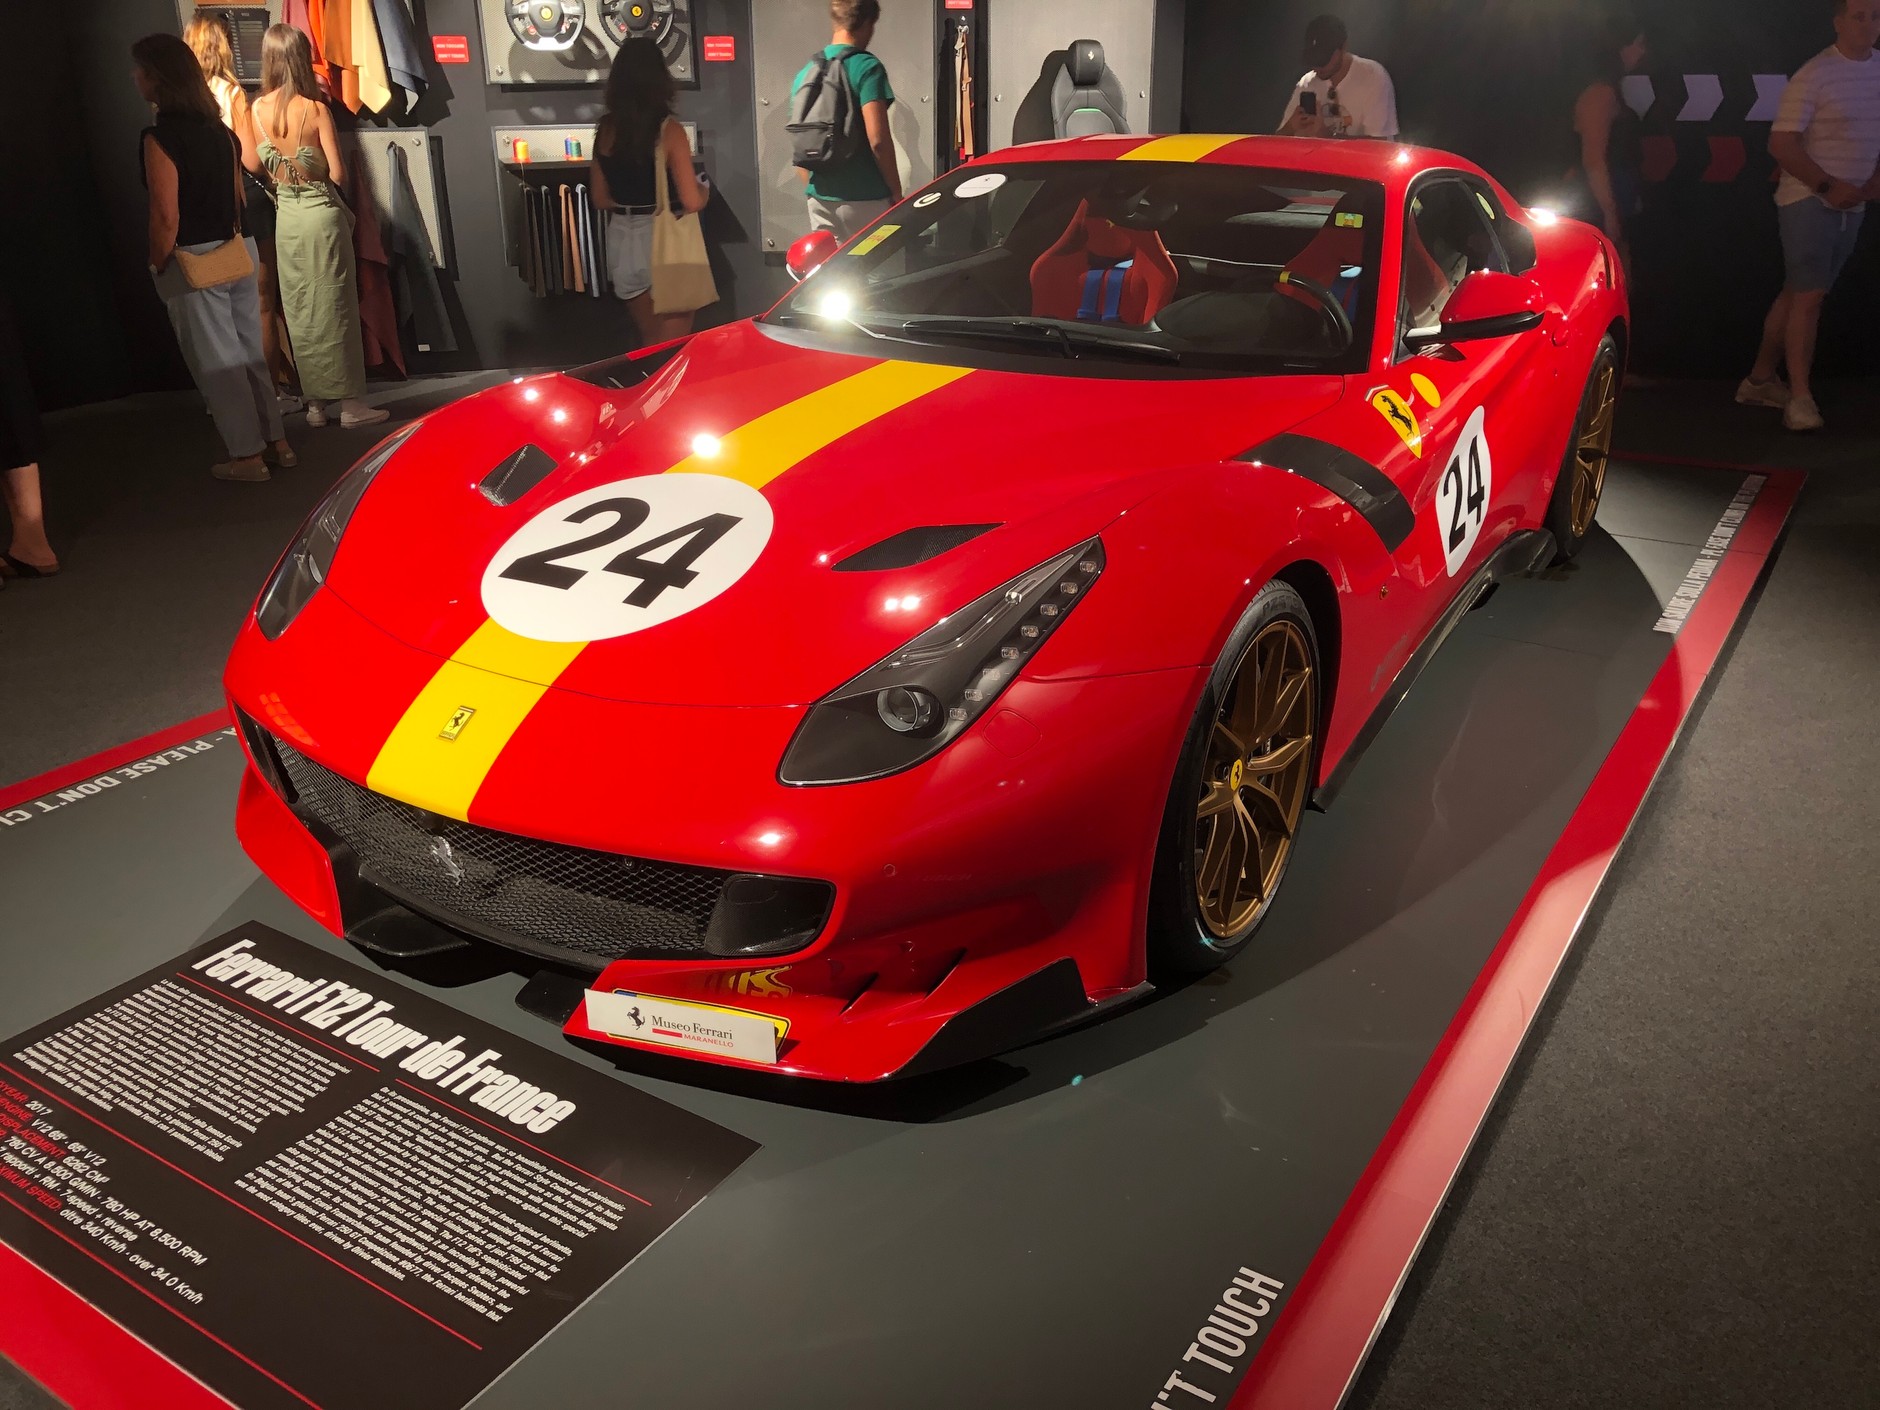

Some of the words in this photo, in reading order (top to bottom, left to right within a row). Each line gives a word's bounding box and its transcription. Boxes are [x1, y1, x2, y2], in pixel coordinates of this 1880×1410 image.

[1443, 435, 1485, 555] 24
[497, 497, 744, 609] 24
[1684, 556, 1718, 580] PEDANA
[1660, 595, 1695, 620] SALIRE
[1674, 577, 1706, 598] SULLA
[116, 739, 214, 779] PLEASE
[34, 775, 122, 813] DON'T
[191, 939, 326, 1015] Ferrari
[300, 981, 373, 1030] F12
[331, 1000, 428, 1059] Tour
[651, 1015, 690, 1032] Museo
[692, 1022, 733, 1040] Ferrari
[398, 1035, 467, 1079] de
[684, 1033, 734, 1048] MARANELLO
[25, 1100, 53, 1115] 2017
[436, 1048, 577, 1134] France
[31, 1118, 53, 1133] V12
[83, 1151, 107, 1166] V12
[62, 1155, 90, 1173] 6262
[1, 1152, 38, 1176] rapporti
[38, 1175, 60, 1190] RM
[60, 1189, 99, 1215] 7-speed
[100, 1216, 138, 1241] reverse
[4, 1136, 27, 1150] 780
[21, 1146, 41, 1159] CV
[34, 1155, 48, 1164] A
[43, 1160, 73, 1179] 8.500
[100, 1196, 124, 1212] 780
[119, 1208, 140, 1221] HP
[134, 1219, 155, 1230] AT
[149, 1227, 182, 1249] 8,500
[177, 1245, 207, 1265] RPM
[26, 1185, 62, 1210] SPEED:
[59, 1209, 83, 1225] oltre
[80, 1221, 105, 1237] 340
[98, 1233, 127, 1253] Km/h
[128, 1254, 155, 1270] over
[173, 1282, 203, 1304] Km/h
[1182, 1266, 1285, 1374] TOUCH
